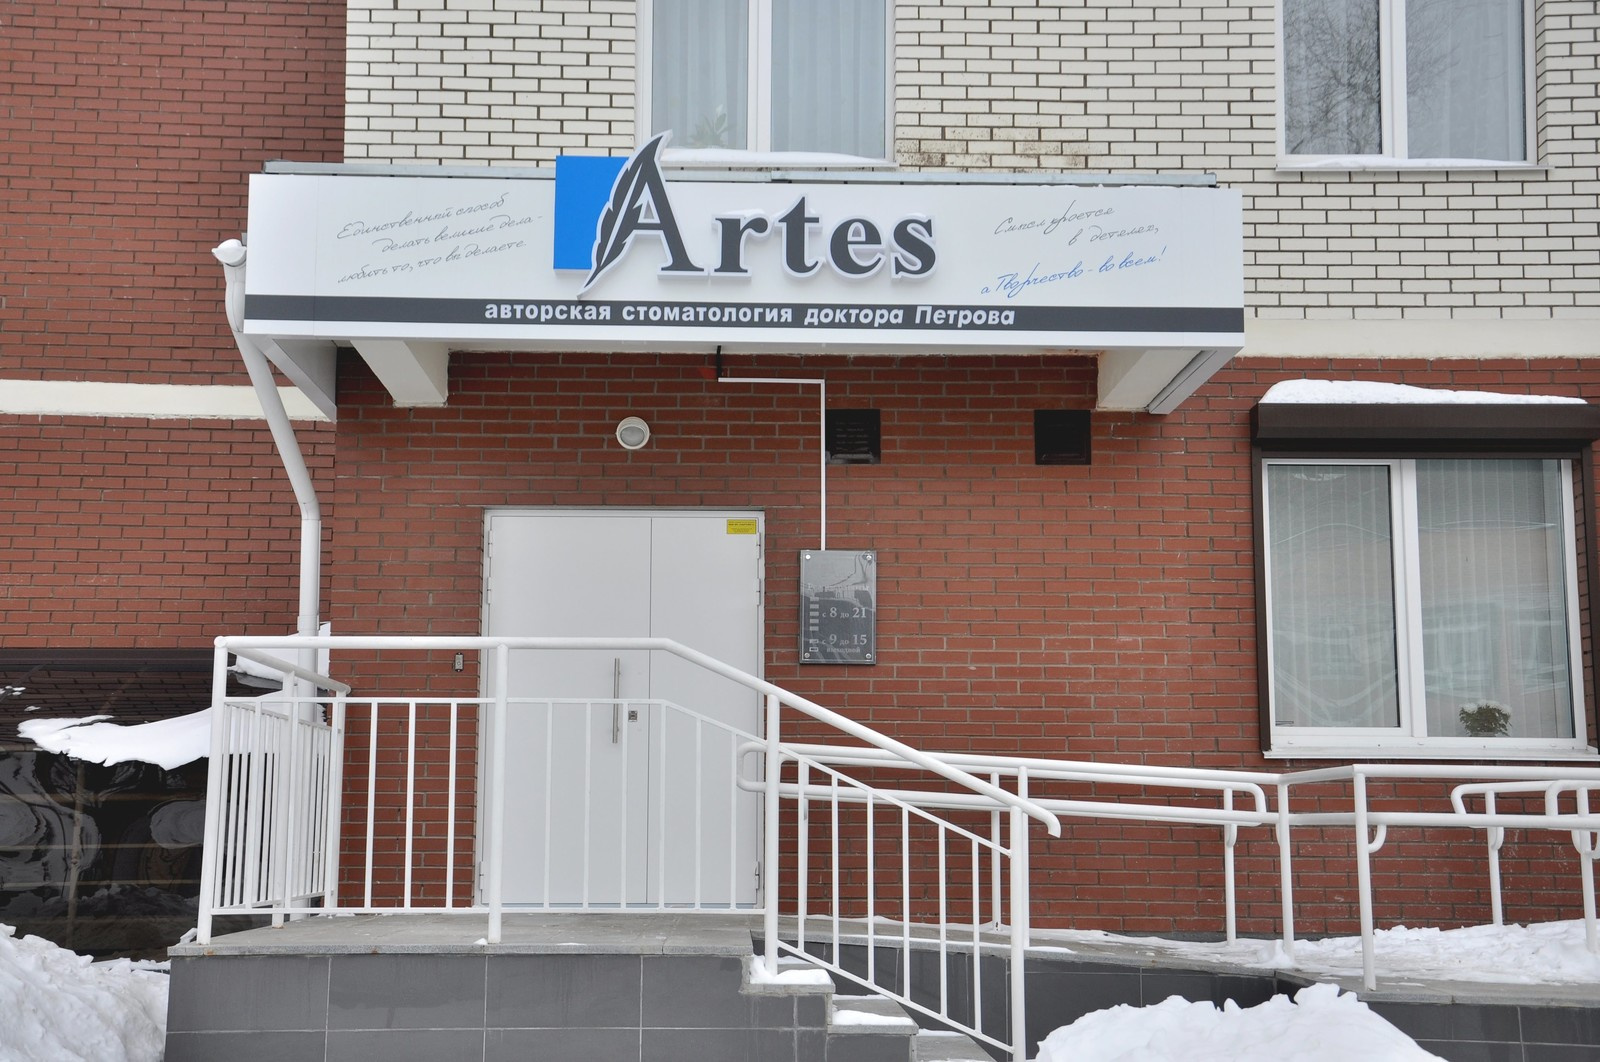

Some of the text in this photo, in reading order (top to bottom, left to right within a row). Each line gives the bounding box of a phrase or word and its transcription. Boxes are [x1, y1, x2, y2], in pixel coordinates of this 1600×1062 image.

[337, 192, 509, 239] Единственный способ
[578, 128, 937, 299] Artes
[994, 217, 1045, 235] Смысл
[372, 237, 430, 253] делать
[434, 226, 495, 243] великие
[1068, 227, 1084, 246] в
[337, 264, 388, 284] любить
[392, 262, 414, 273] то,
[418, 256, 442, 268] что
[980, 286, 991, 295] а
[996, 261, 1083, 299] Творчество
[1098, 255, 1115, 274] во
[1119, 246, 1168, 268] всем!
[484, 302, 1016, 328] авторская стоматология доктора Петрова
[829, 607, 837, 618] 8
[852, 607, 867, 618] 21
[829, 633, 837, 645] 9
[852, 634, 868, 646] 15
